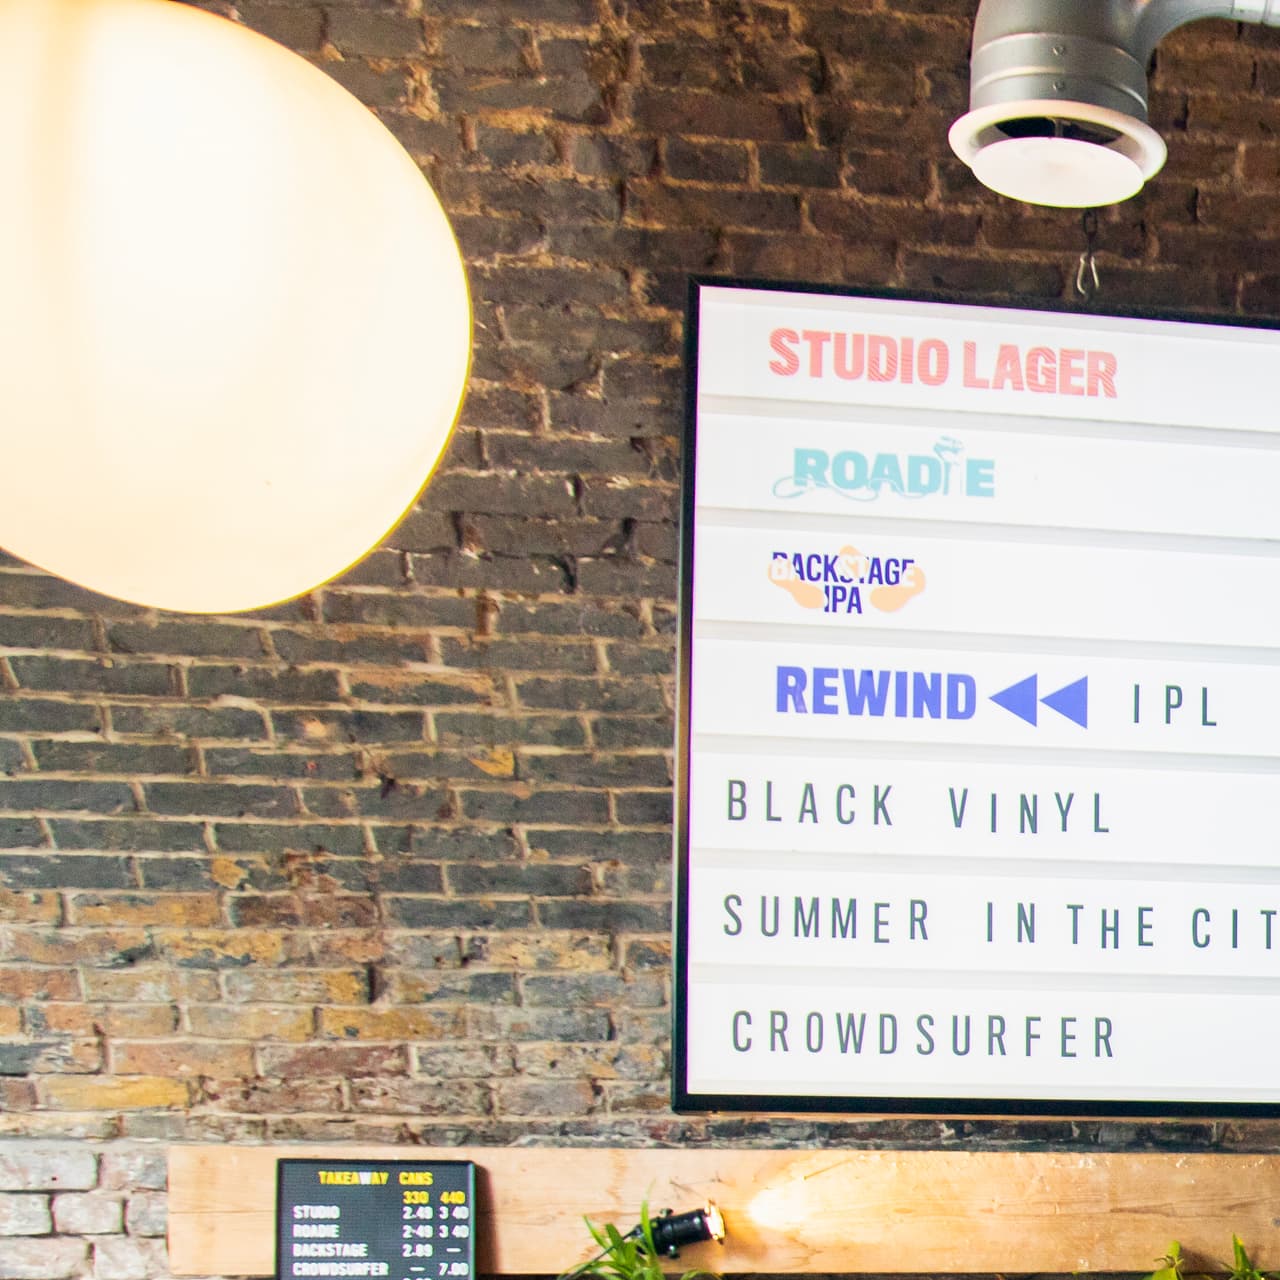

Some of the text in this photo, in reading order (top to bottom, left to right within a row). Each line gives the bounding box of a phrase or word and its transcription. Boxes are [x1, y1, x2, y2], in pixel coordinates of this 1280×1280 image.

[770, 328, 1116, 397] STUDIO LAGER
[773, 435, 995, 502] ROADIE
[823, 584, 863, 615] IPA
[775, 664, 1217, 726] REWIND IPL
[728, 780, 1109, 834] BLACK VINYL
[724, 894, 928, 943] SUMMER
[987, 902, 1035, 943] IN
[1067, 904, 1153, 949] THE
[733, 1010, 1112, 1057] CROWDSURFER
[319, 1171, 433, 1185] TAKEAWAY CANS
[292, 1205, 340, 1219] STUDIO
[403, 1191, 465, 1204] 330 440
[292, 1224, 339, 1238] ROADIE
[292, 1243, 368, 1257] BACKSTAGE
[292, 1262, 389, 1276] CROWDSURFER
